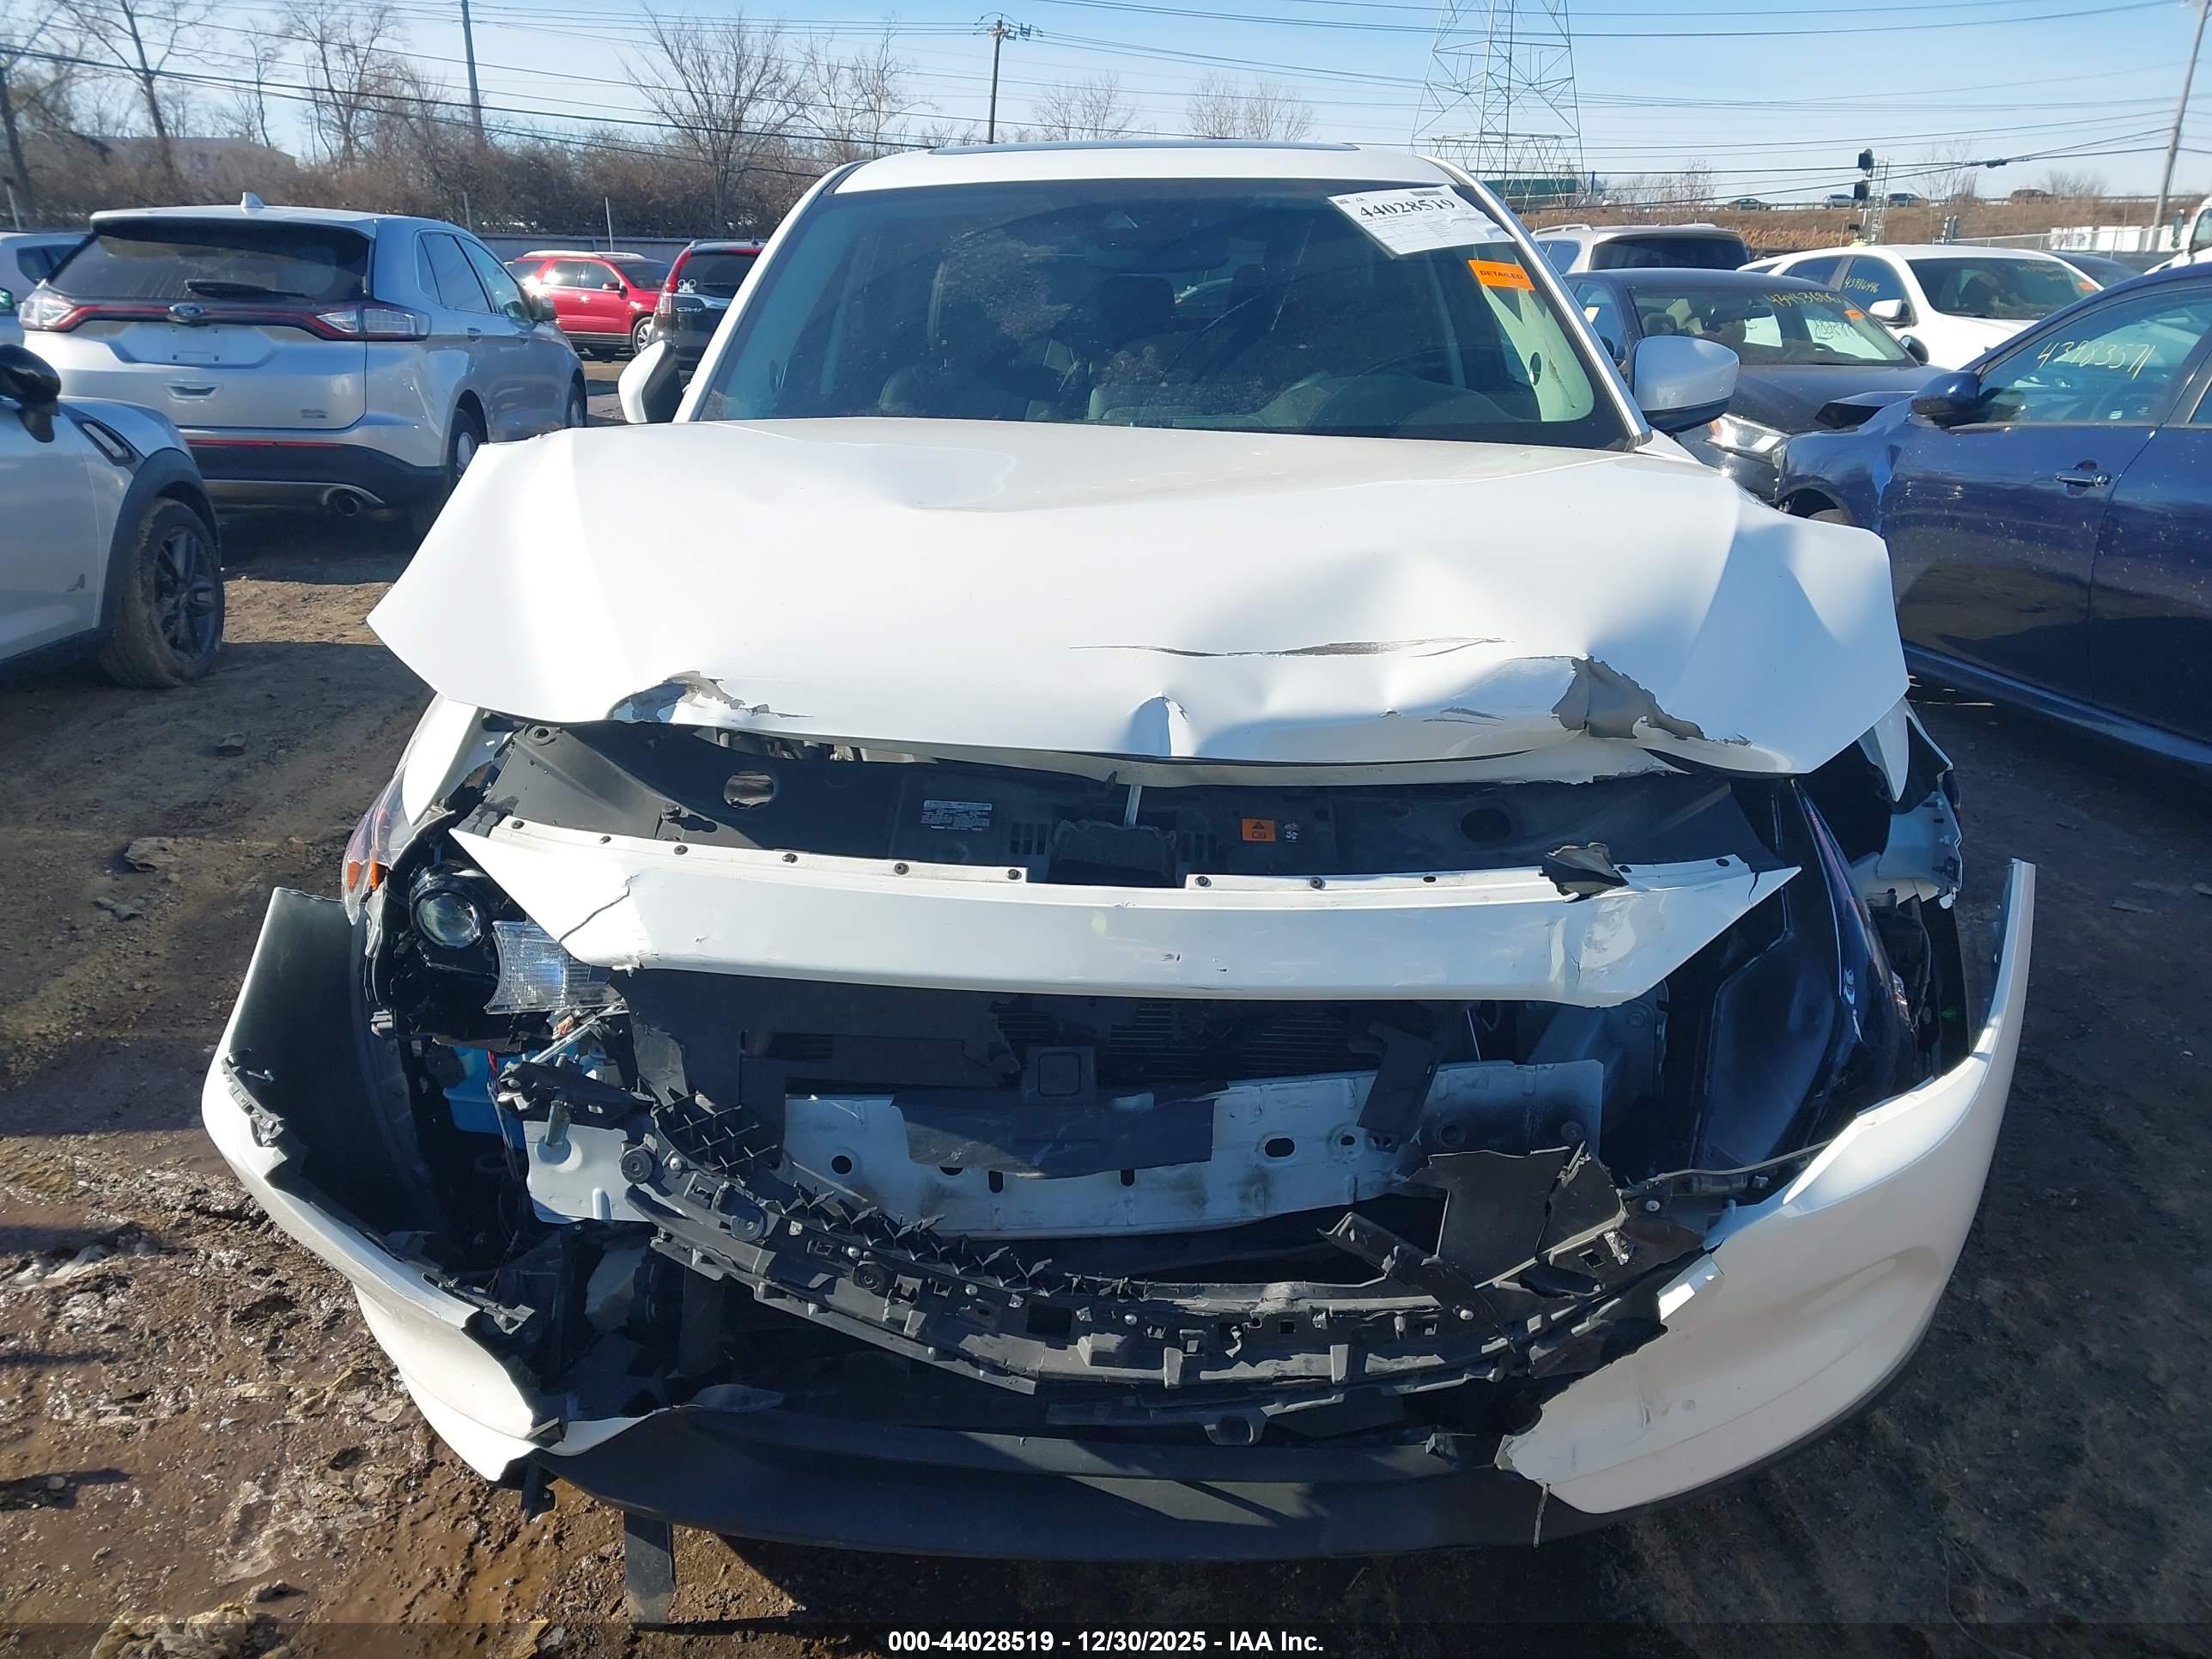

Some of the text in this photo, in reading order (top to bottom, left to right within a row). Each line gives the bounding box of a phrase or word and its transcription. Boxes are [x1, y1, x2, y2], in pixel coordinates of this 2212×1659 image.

[1360, 198, 1455, 217] 44028519
[1480, 270, 1523, 280] DETAILED
[2037, 340, 2156, 381] 43983571
